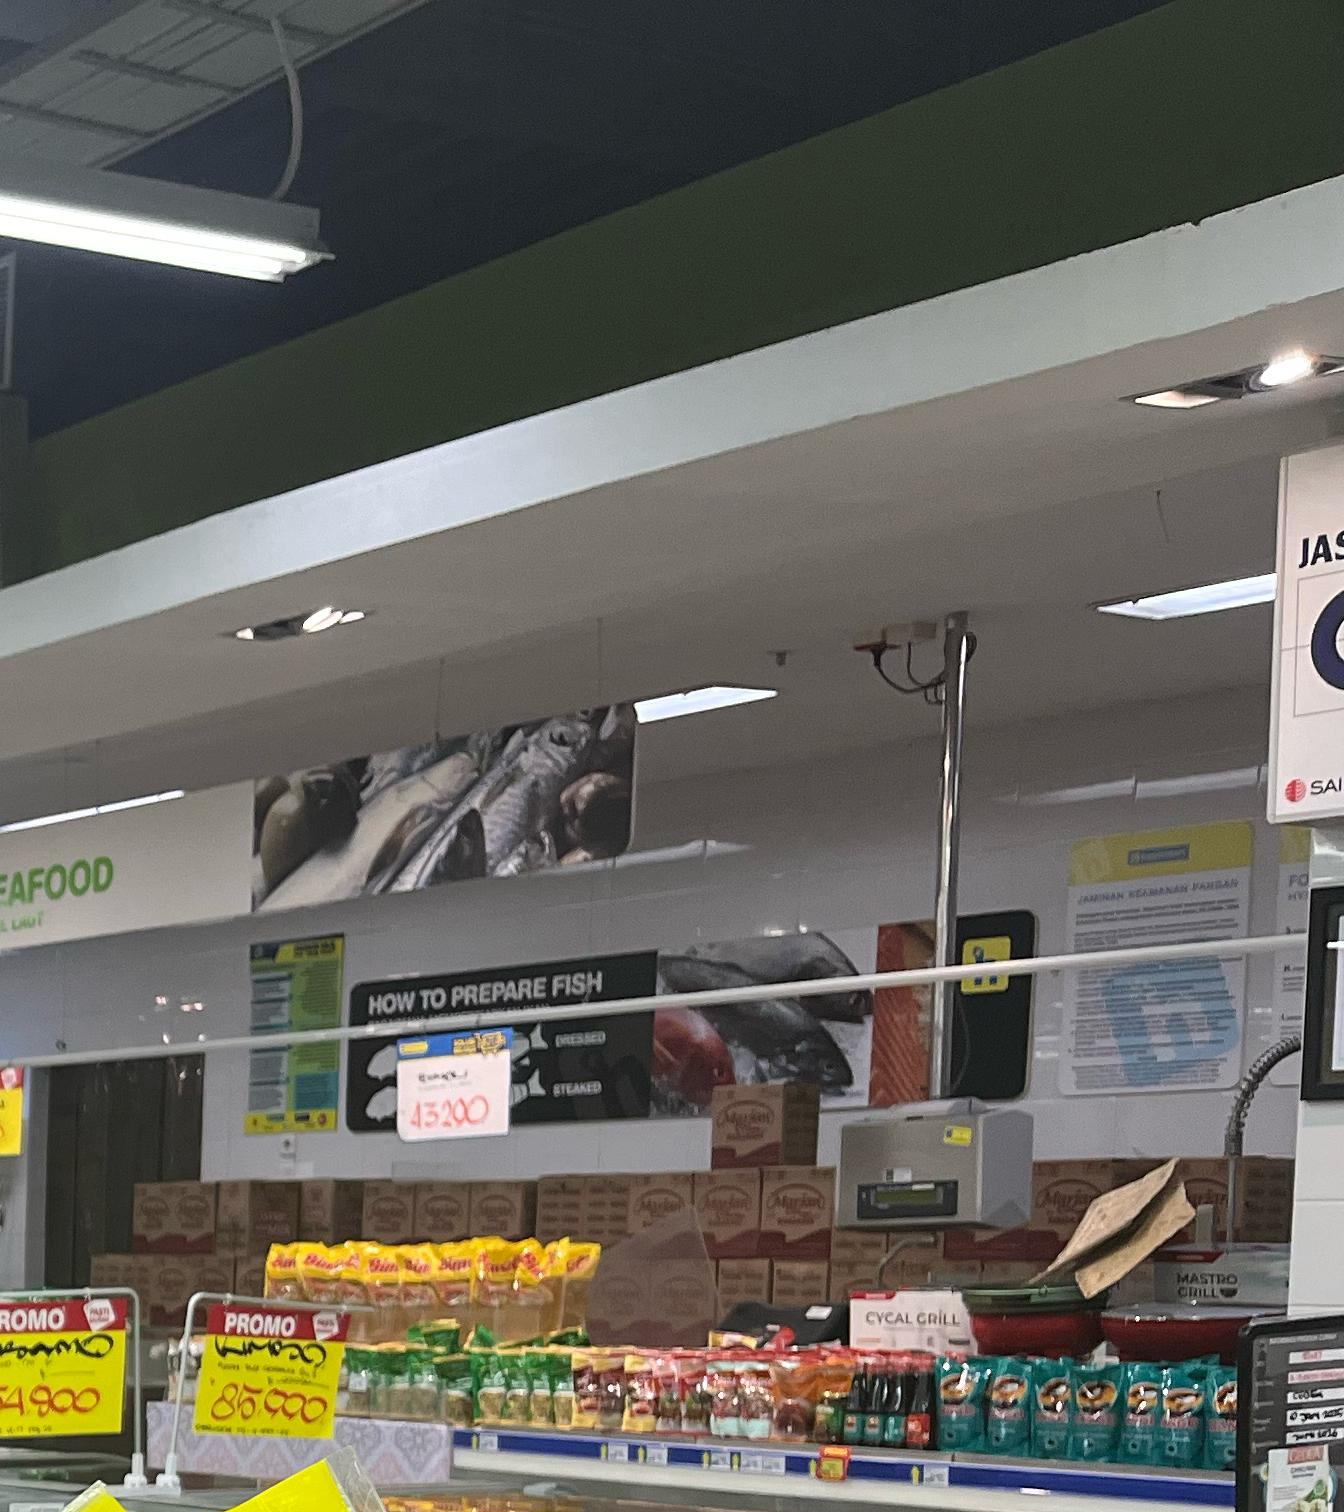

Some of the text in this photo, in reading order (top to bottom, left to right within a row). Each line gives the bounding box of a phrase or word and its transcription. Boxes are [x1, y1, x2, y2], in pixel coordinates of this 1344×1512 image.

[368, 990, 416, 1017] HOW
[421, 988, 448, 1010] TO
[451, 977, 547, 1008] PREPARE
[552, 970, 603, 997] FISH
[553, 1081, 602, 1098] STEAKED
[1177, 1272, 1238, 1286] MASTRO
[1177, 1286, 1219, 1299] GRILL
[224, 1312, 297, 1337] PROMO
[865, 1310, 912, 1326] CYCAL
